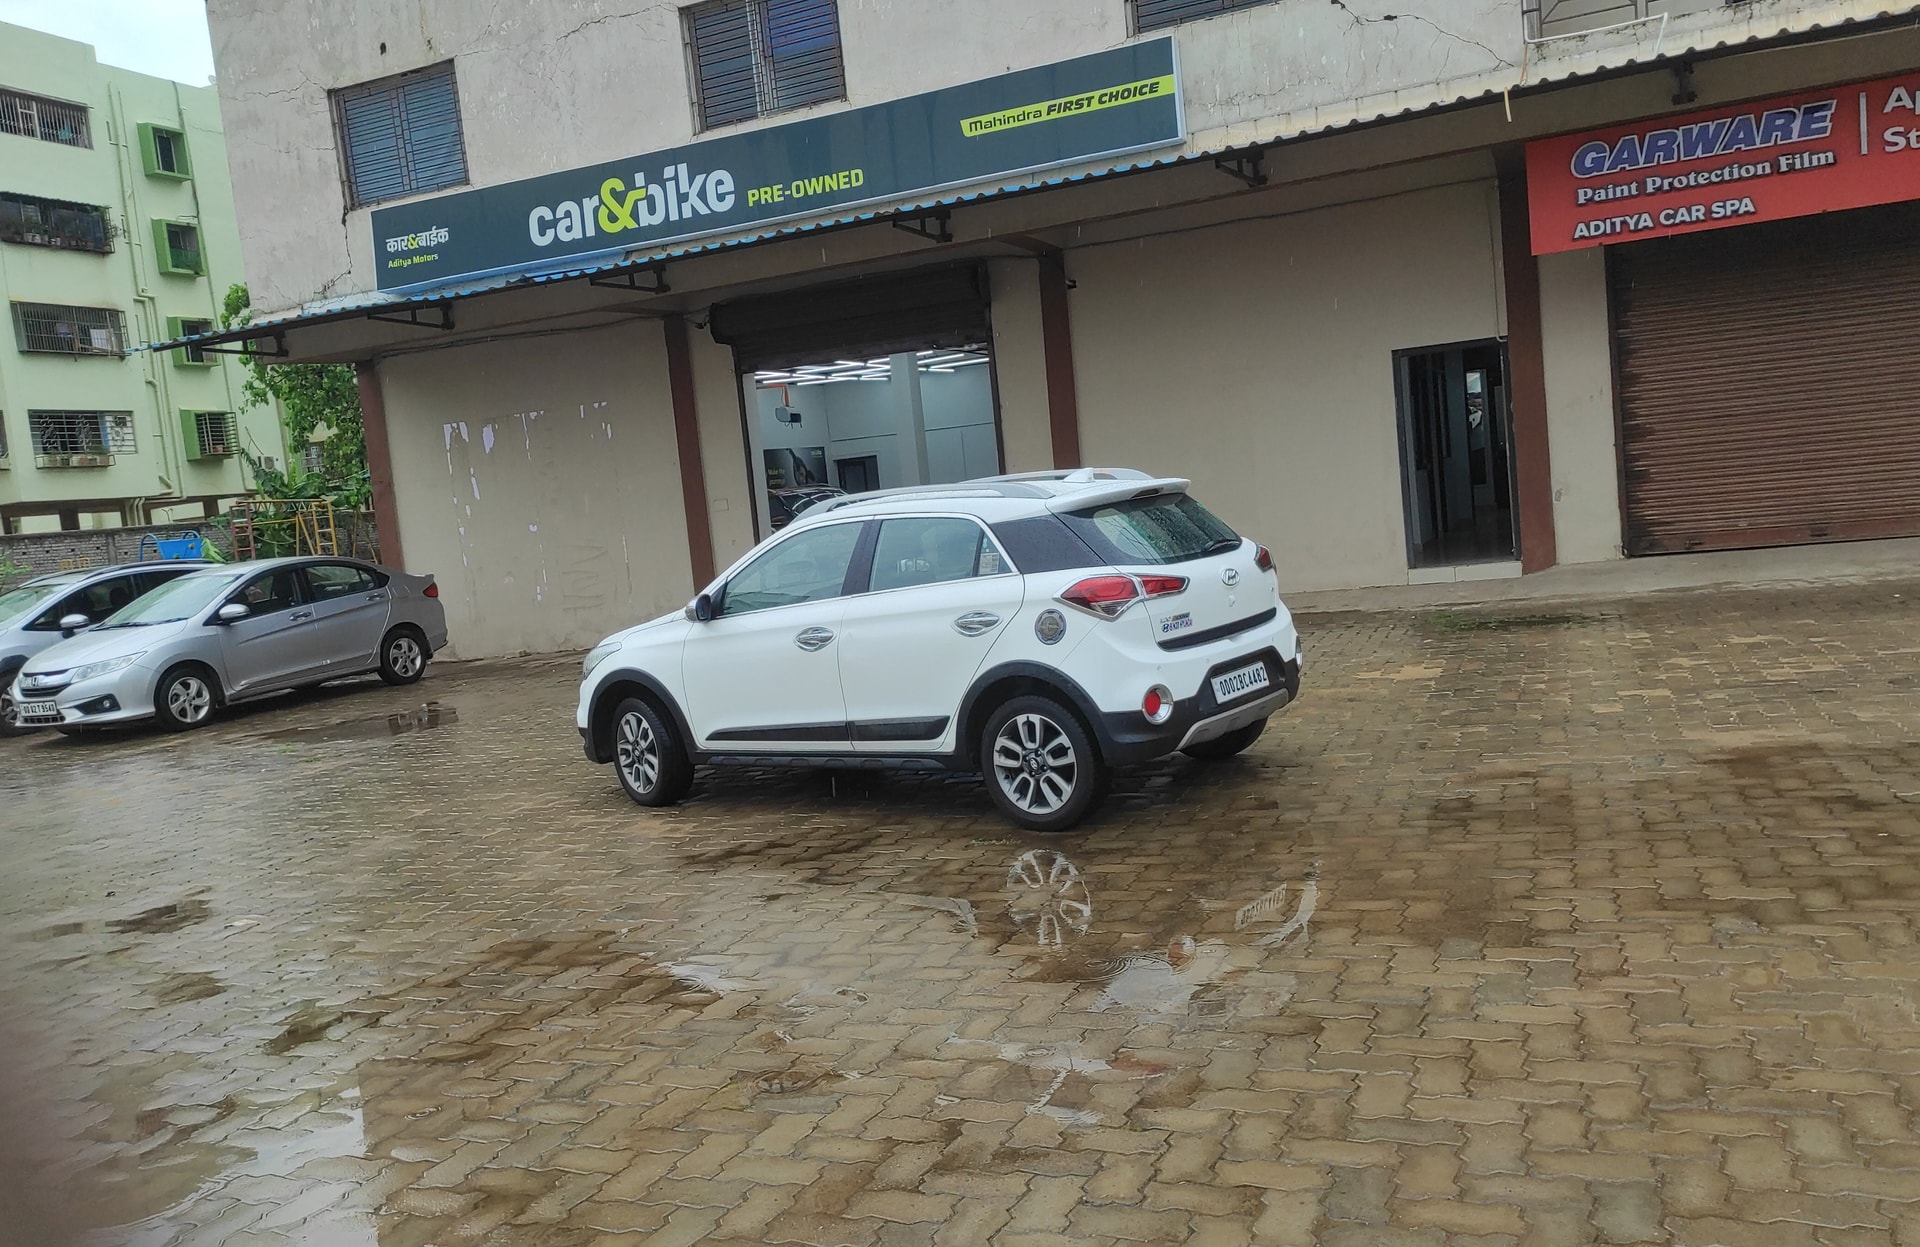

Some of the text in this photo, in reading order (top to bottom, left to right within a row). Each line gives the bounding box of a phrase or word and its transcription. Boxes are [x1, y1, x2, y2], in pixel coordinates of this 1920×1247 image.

[968, 81, 1160, 132] Mahindra FIRST CHOICE
[1883, 86, 1920, 115] A
[1570, 99, 1837, 179] GARWARE
[1576, 150, 1835, 205] Paint Protection Film
[528, 162, 864, 247] car&bike PRE-OWNED
[1572, 197, 1756, 240] ADITYA CAR SPA
[388, 252, 439, 269] Aditya Motors
